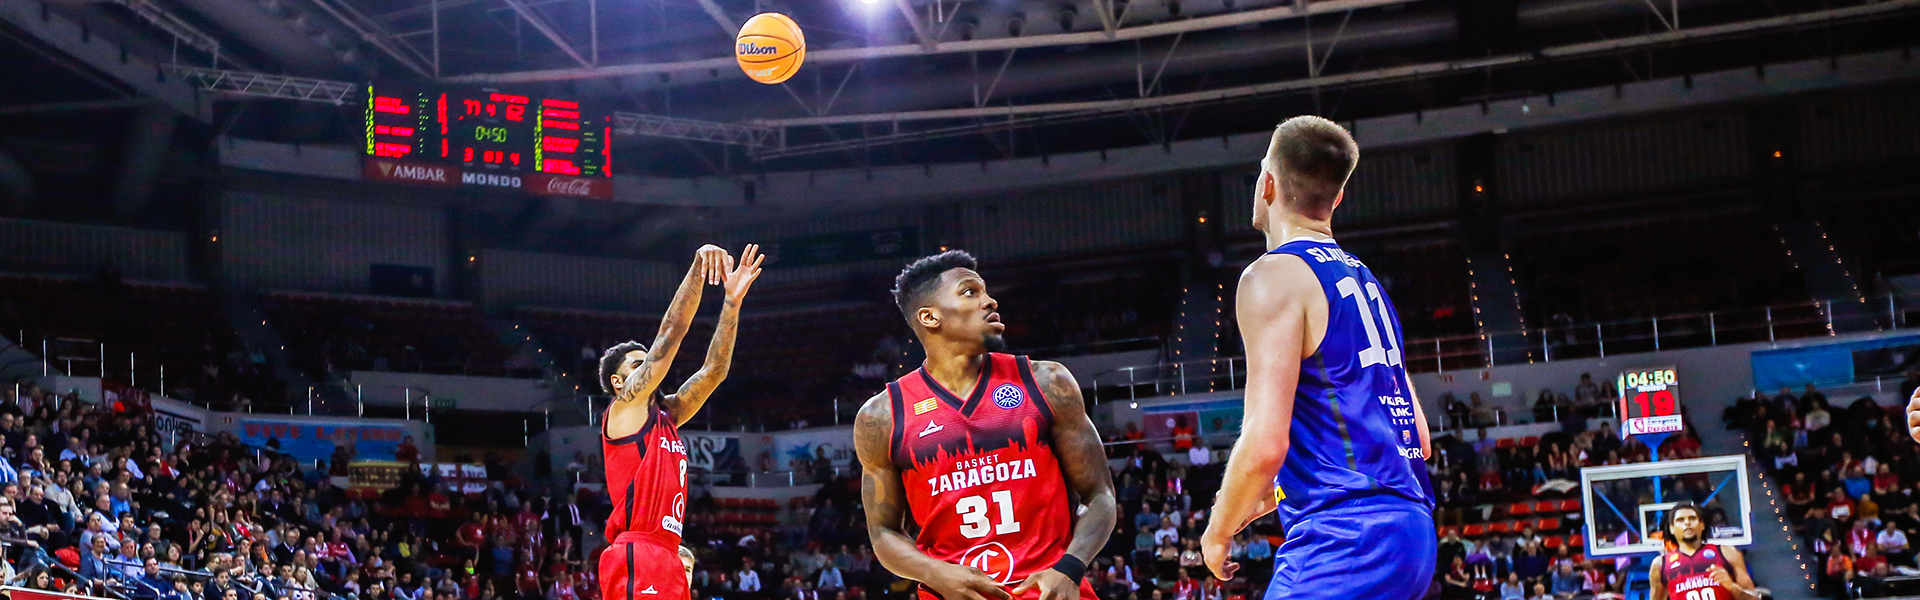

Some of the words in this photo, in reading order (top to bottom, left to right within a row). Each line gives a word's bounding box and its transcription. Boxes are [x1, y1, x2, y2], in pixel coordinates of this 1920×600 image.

[739, 42, 777, 55] Wilson
[394, 165, 446, 182] AMBAR
[462, 172, 521, 188] MONDO
[1335, 276, 1403, 369] 11
[1627, 369, 1676, 388] 04:50
[1633, 390, 1675, 418] 19
[956, 454, 999, 470] BASKET
[928, 458, 1037, 496] ZARAGOZA
[955, 490, 1020, 539] 31
